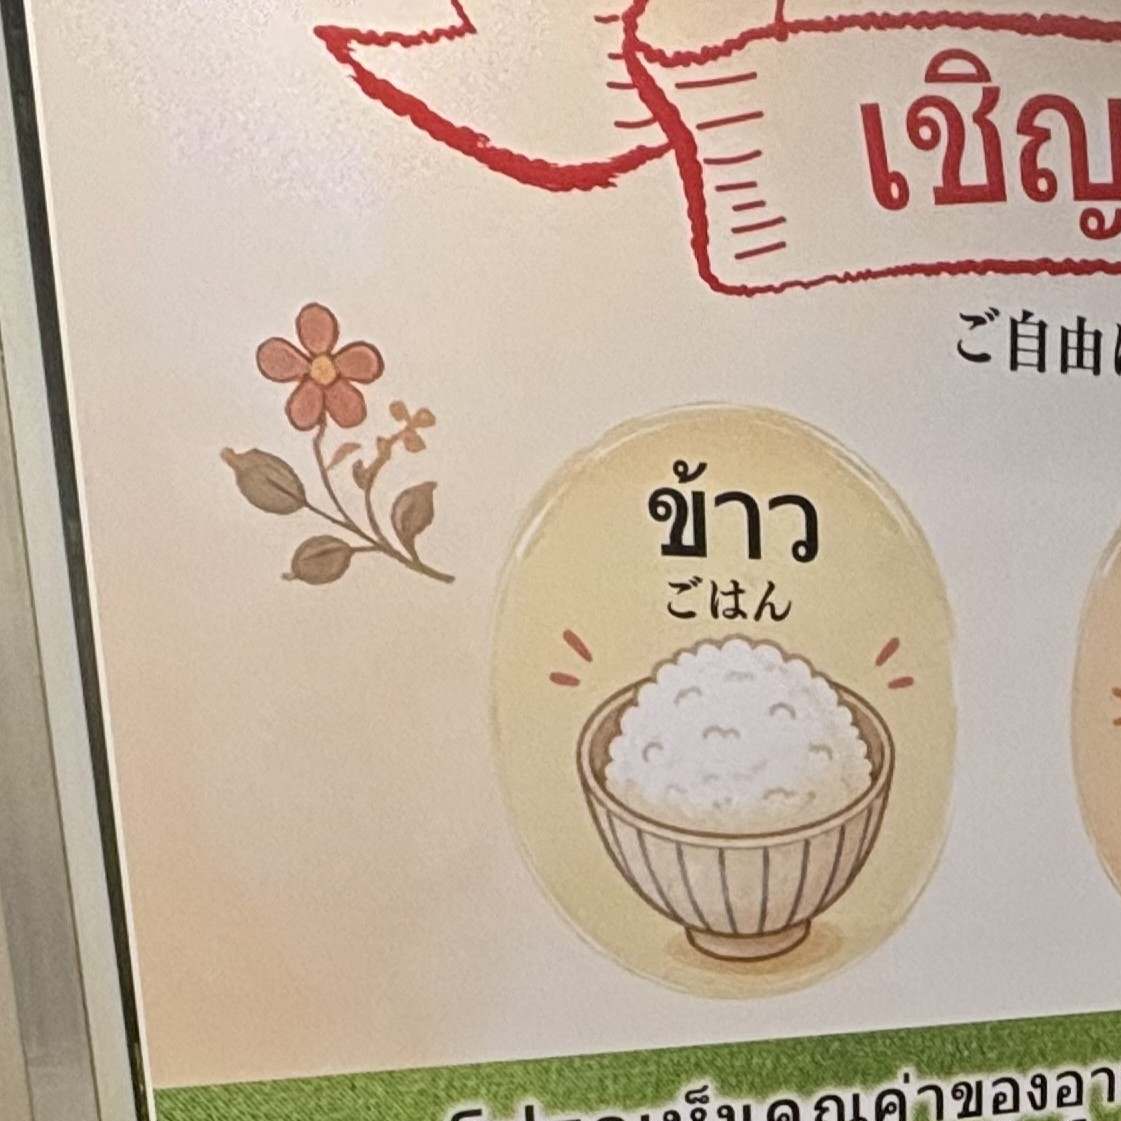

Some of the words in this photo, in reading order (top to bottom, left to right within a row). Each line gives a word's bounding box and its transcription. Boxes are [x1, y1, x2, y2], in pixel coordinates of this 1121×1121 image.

[648, 459, 819, 563] ข้าว
[667, 576, 792, 622] ごはん
